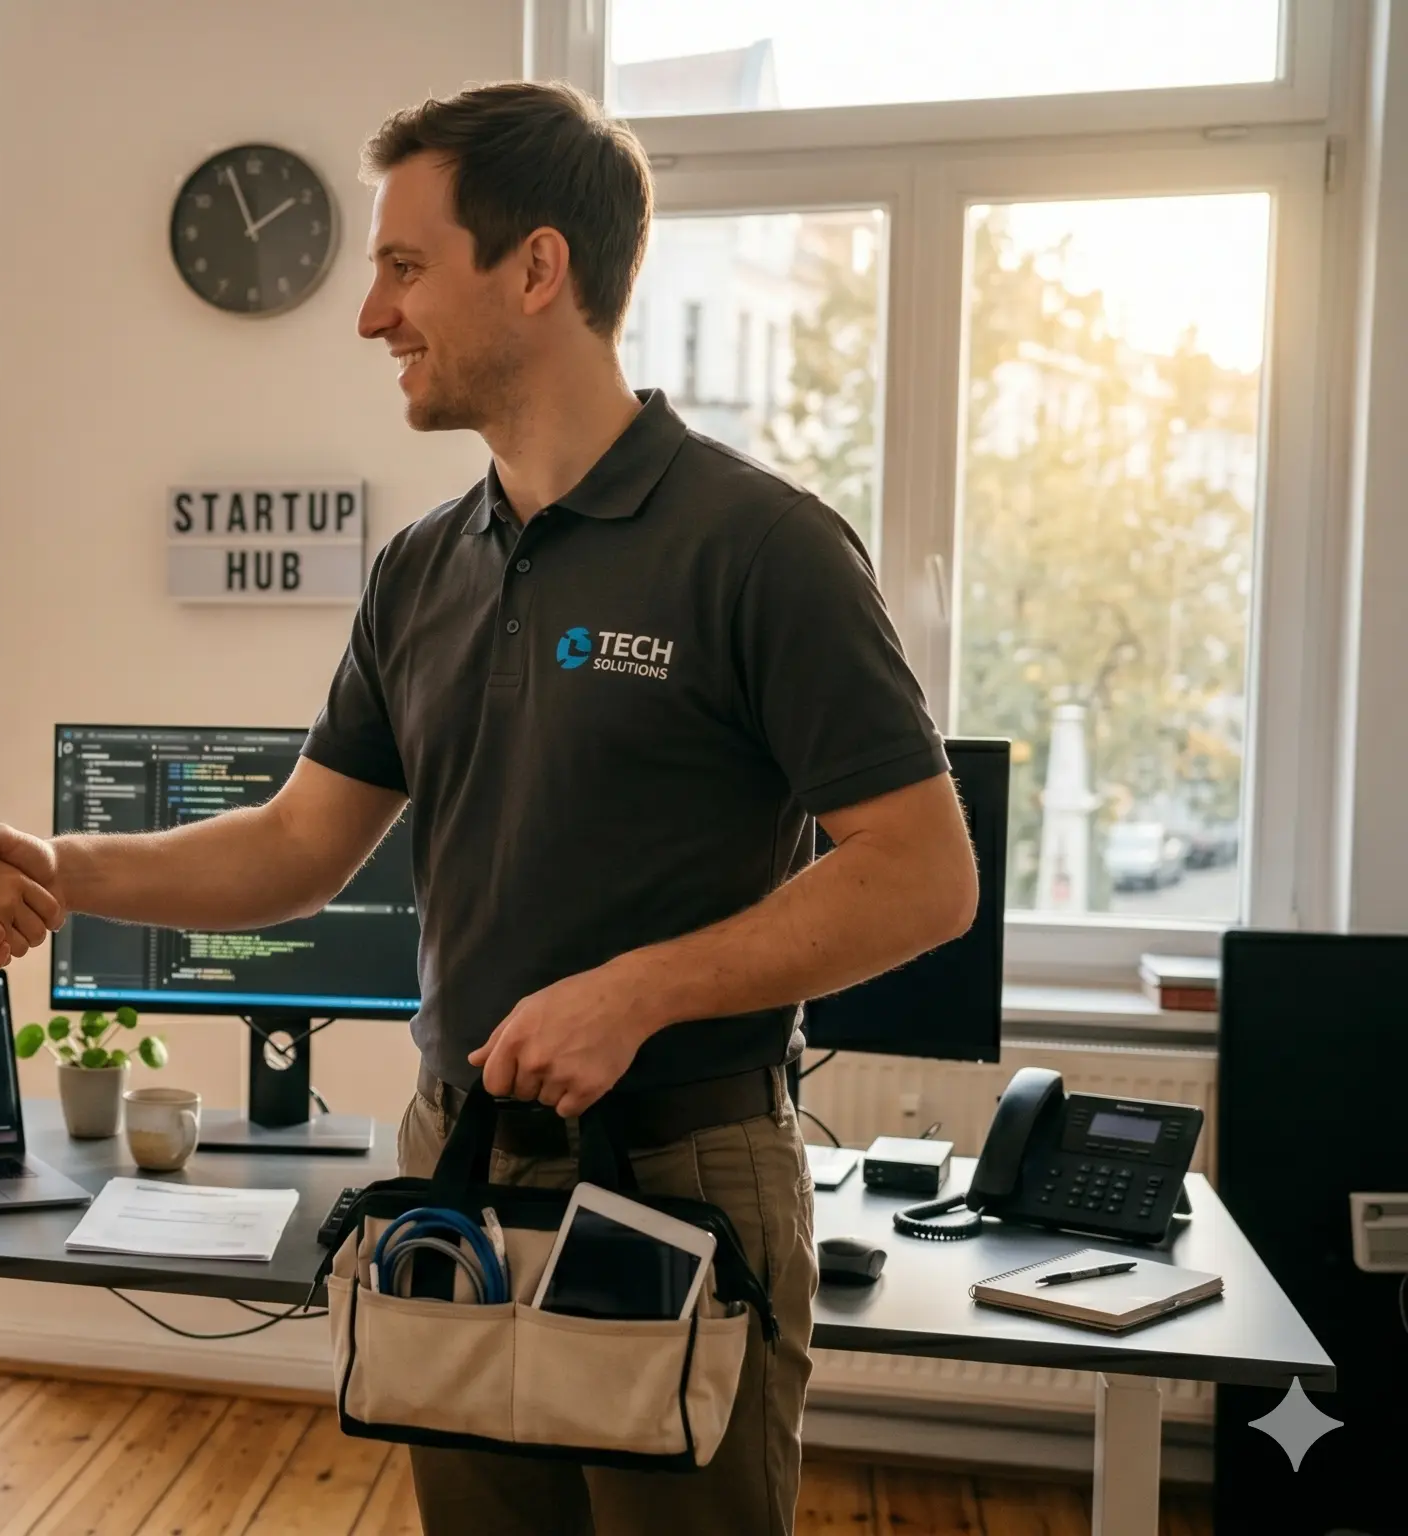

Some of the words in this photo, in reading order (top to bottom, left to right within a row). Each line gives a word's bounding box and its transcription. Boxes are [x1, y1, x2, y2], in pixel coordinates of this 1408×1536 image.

[174, 492, 355, 533] STARTUP
[226, 551, 301, 591] HUB
[598, 631, 674, 664] TECH
[593, 658, 669, 680] SOLUTIONS
